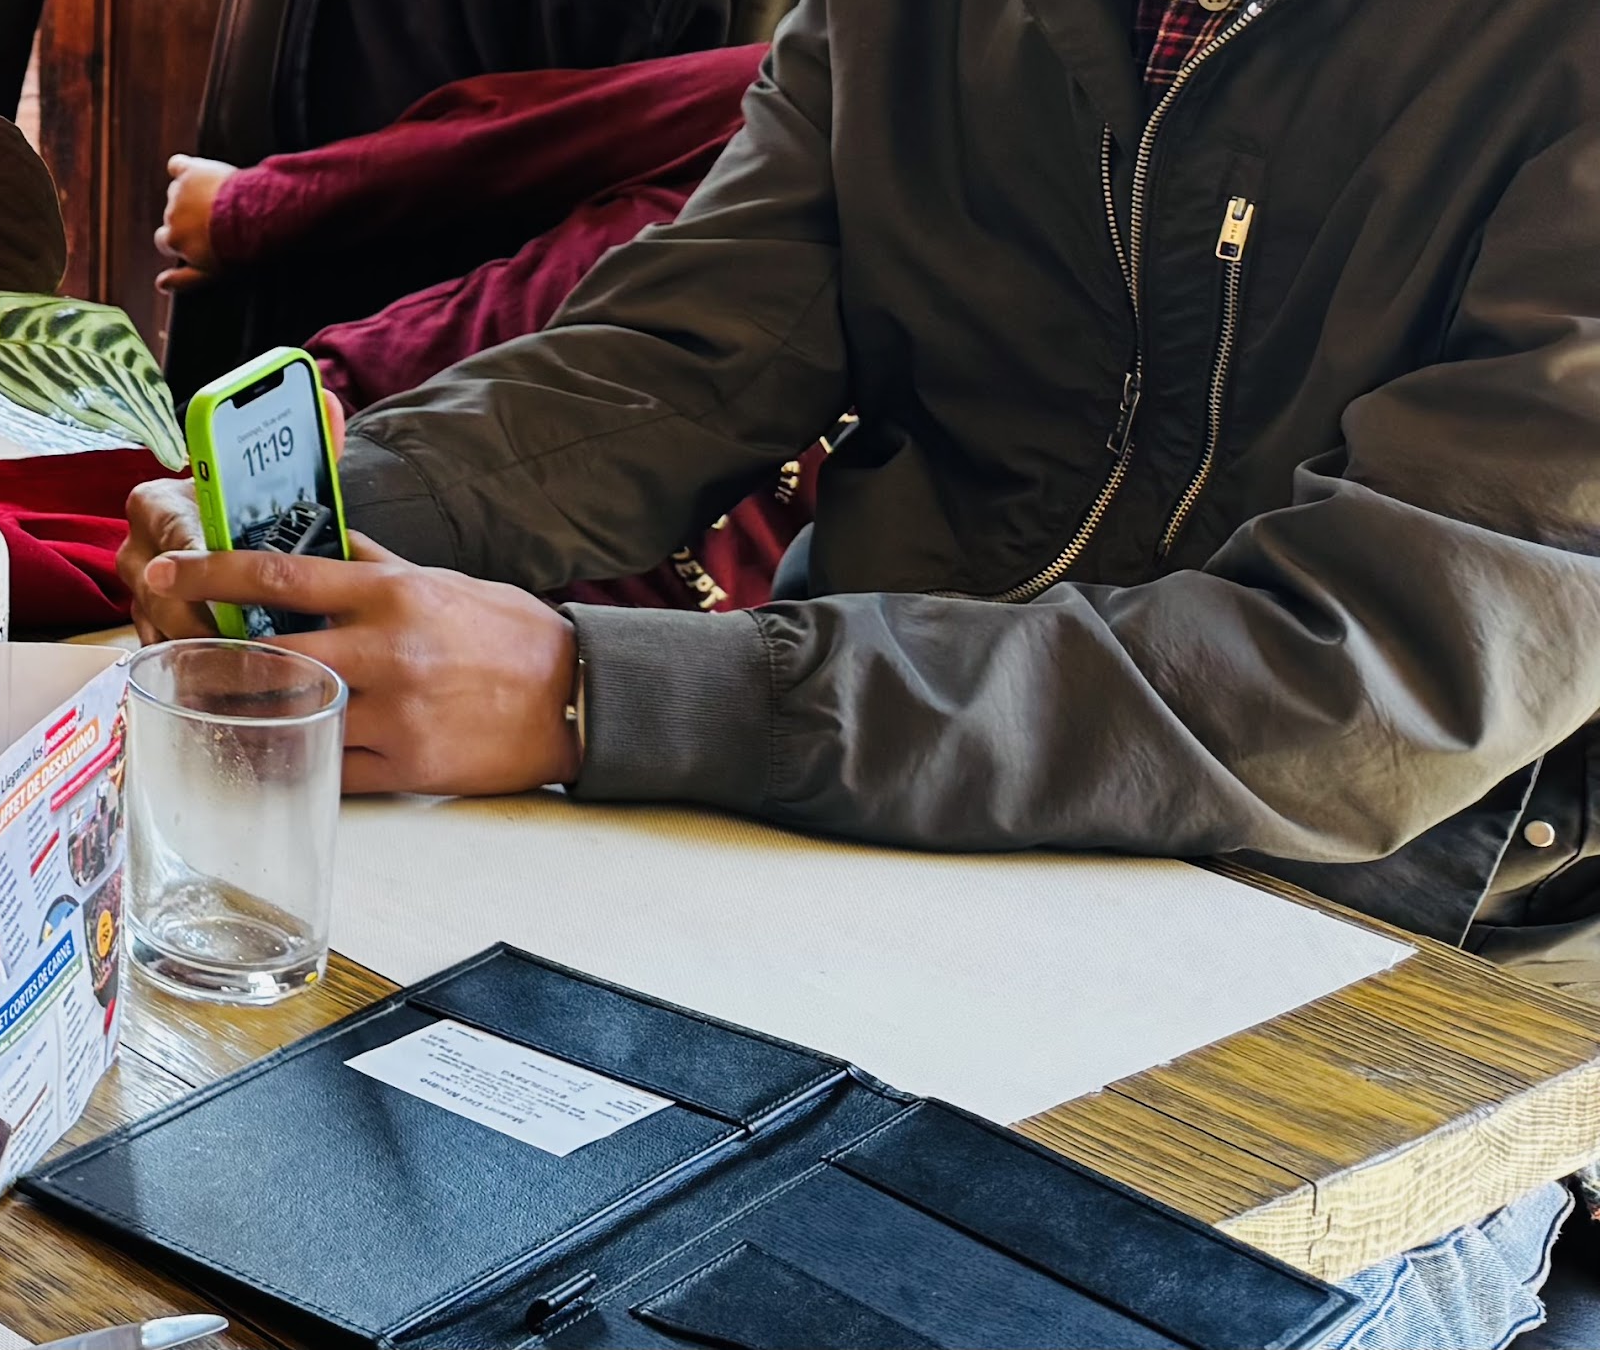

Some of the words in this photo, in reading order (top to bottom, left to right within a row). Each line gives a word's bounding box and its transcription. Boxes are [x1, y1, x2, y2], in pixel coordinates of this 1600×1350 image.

[243, 426, 294, 477] 11:19
[1, 757, 31, 793] Llegaron
[27, 775, 40, 799] DE
[42, 726, 95, 785] DESAYUNO
[9, 979, 36, 1018] CORTES
[37, 967, 47, 990] DE
[48, 940, 72, 975] CARNE
